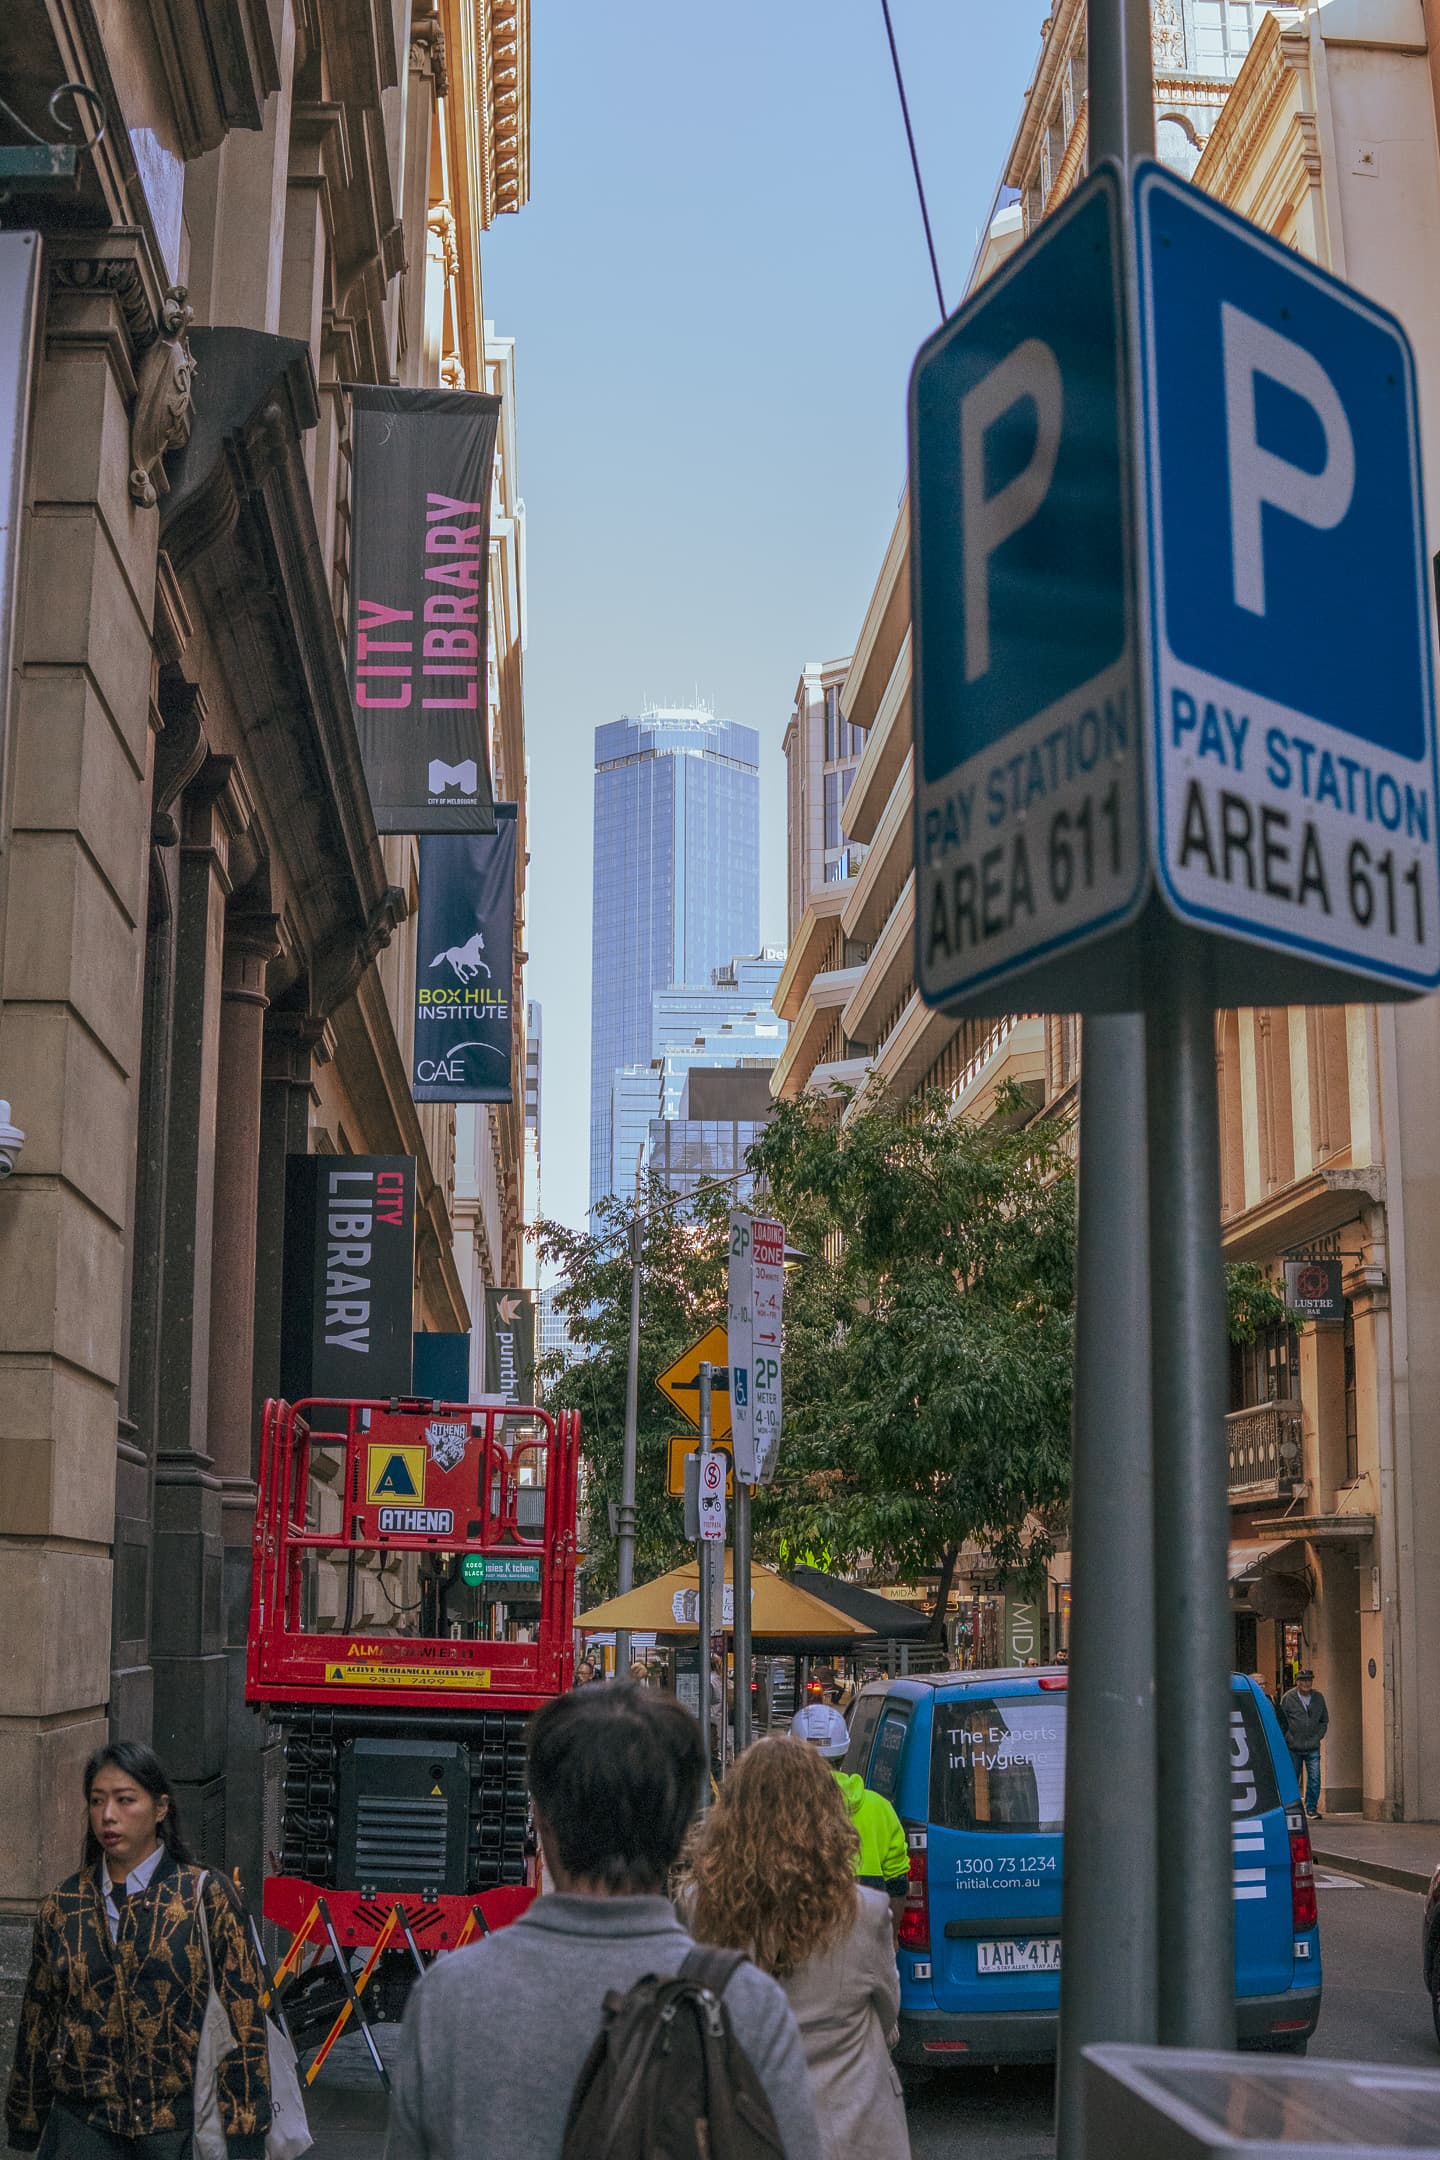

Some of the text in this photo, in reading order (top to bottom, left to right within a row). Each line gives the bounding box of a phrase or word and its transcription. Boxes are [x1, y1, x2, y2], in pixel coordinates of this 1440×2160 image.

[1221, 300, 1356, 617] P
[961, 338, 1063, 684] P
[422, 493, 481, 710] LIBRARY
[356, 600, 414, 709] CITY
[1171, 687, 1429, 844] PAY STATION
[925, 688, 1129, 866] PAY STATION
[1180, 778, 1425, 946] AREA 611
[926, 780, 1121, 968] AREA 611
[418, 989, 508, 1004] BOX HILL
[418, 1006, 508, 1020] INSTITUTE
[417, 1060, 465, 1082] CAE
[376, 1172, 404, 1226] CITY
[732, 1224, 750, 1257] 2P
[754, 1223, 783, 1244] LOADING
[325, 1171, 374, 1353] LIBRARY
[753, 1244, 783, 1264] ZONE
[755, 1267, 765, 1279] 30
[1294, 1299, 1334, 1308] LUSTRE
[755, 1358, 778, 1389] 2P
[757, 1393, 777, 1405] METER
[431, 1423, 466, 1439] ATHENA
[381, 1510, 451, 1532] ATHENA
[378, 1667, 430, 1675] MECHANICAL
[947, 1727, 1057, 1746] The Experts
[949, 1751, 1048, 1771] in Hygiene
[955, 1856, 1057, 1874] 1300 73 1234
[956, 1878, 1041, 1890] initial.com.au
